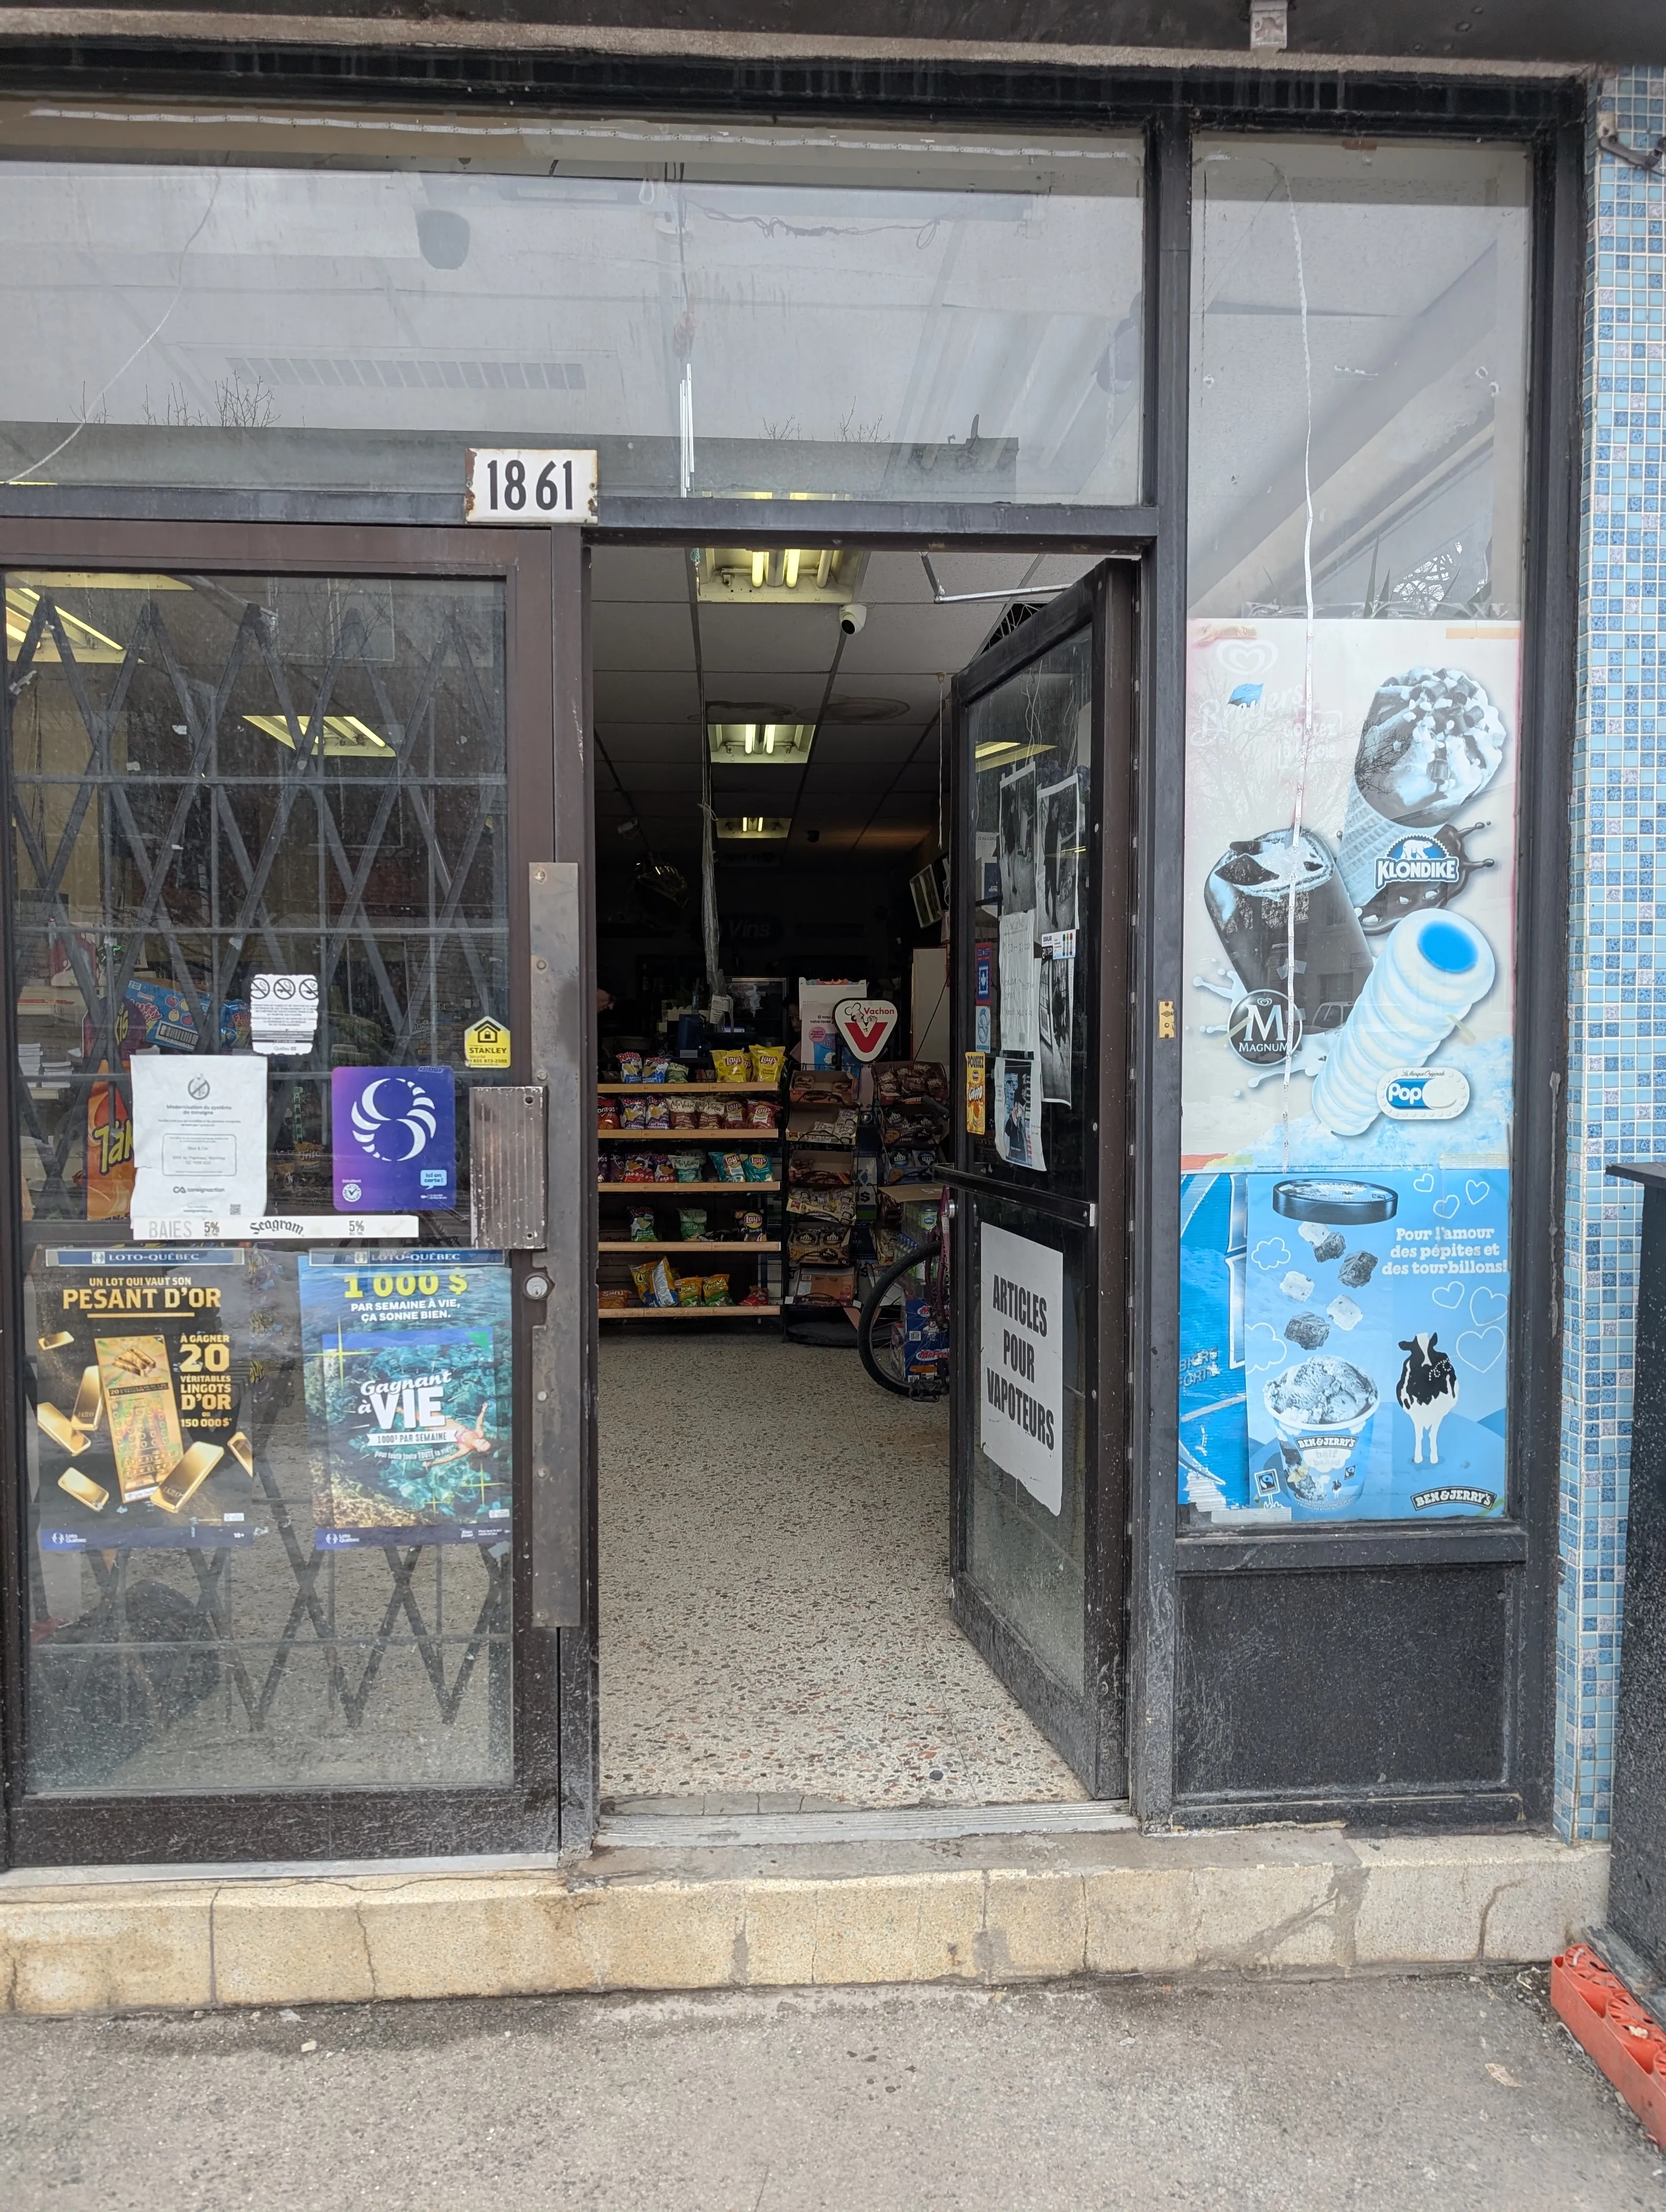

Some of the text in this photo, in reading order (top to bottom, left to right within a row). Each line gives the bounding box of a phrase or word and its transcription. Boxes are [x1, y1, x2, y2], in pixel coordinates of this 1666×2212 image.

[487, 459, 573, 511] 1861
[1377, 860, 1456, 888] KLONDIKE
[728, 918, 772, 938] Vins
[863, 1007, 895, 1015] Vachon
[1239, 1042, 1288, 1052] MAGNUM
[967, 1055, 984, 1069] POUSSEZ
[148, 1221, 193, 1239] BAIES
[204, 1221, 220, 1233] 5%
[249, 1218, 305, 1236] Seagram
[349, 1220, 365, 1232] 5%
[1396, 1226, 1495, 1241] Pour l'amour
[109, 1252, 199, 1261] LOTO-QUÉBEC
[371, 1252, 460, 1261] LOTO-QUÉBEC
[1390, 1243, 1500, 1261] des pépites et
[1382, 1259, 1508, 1275] des tourbillons!
[89, 1277, 192, 1287] UN LOT QUI VAUT SON
[373, 1270, 439, 1298] 000
[63, 1287, 222, 1309] PESANT D'OR
[351, 1297, 461, 1312] PAR SEMAINE À VIE,
[992, 1274, 1048, 1338] ARTICLES
[361, 1310, 452, 1323] ÇA SONNE BIEN.
[180, 1332, 230, 1343] À GAGNER
[179, 1343, 230, 1373] 20
[1003, 1328, 1035, 1384] POUR
[180, 1374, 231, 1383] VÉRITABLES
[360, 1369, 453, 1397] Gagnant
[180, 1384, 231, 1393] LINGOTS
[181, 1394, 231, 1410] D'OR
[357, 1386, 447, 1430] à VIE
[986, 1366, 1055, 1451] VAPOTEURS
[181, 1419, 199, 1427] 150
[399, 1433, 414, 1443] PAR
[415, 1432, 447, 1442] SEMAINE
